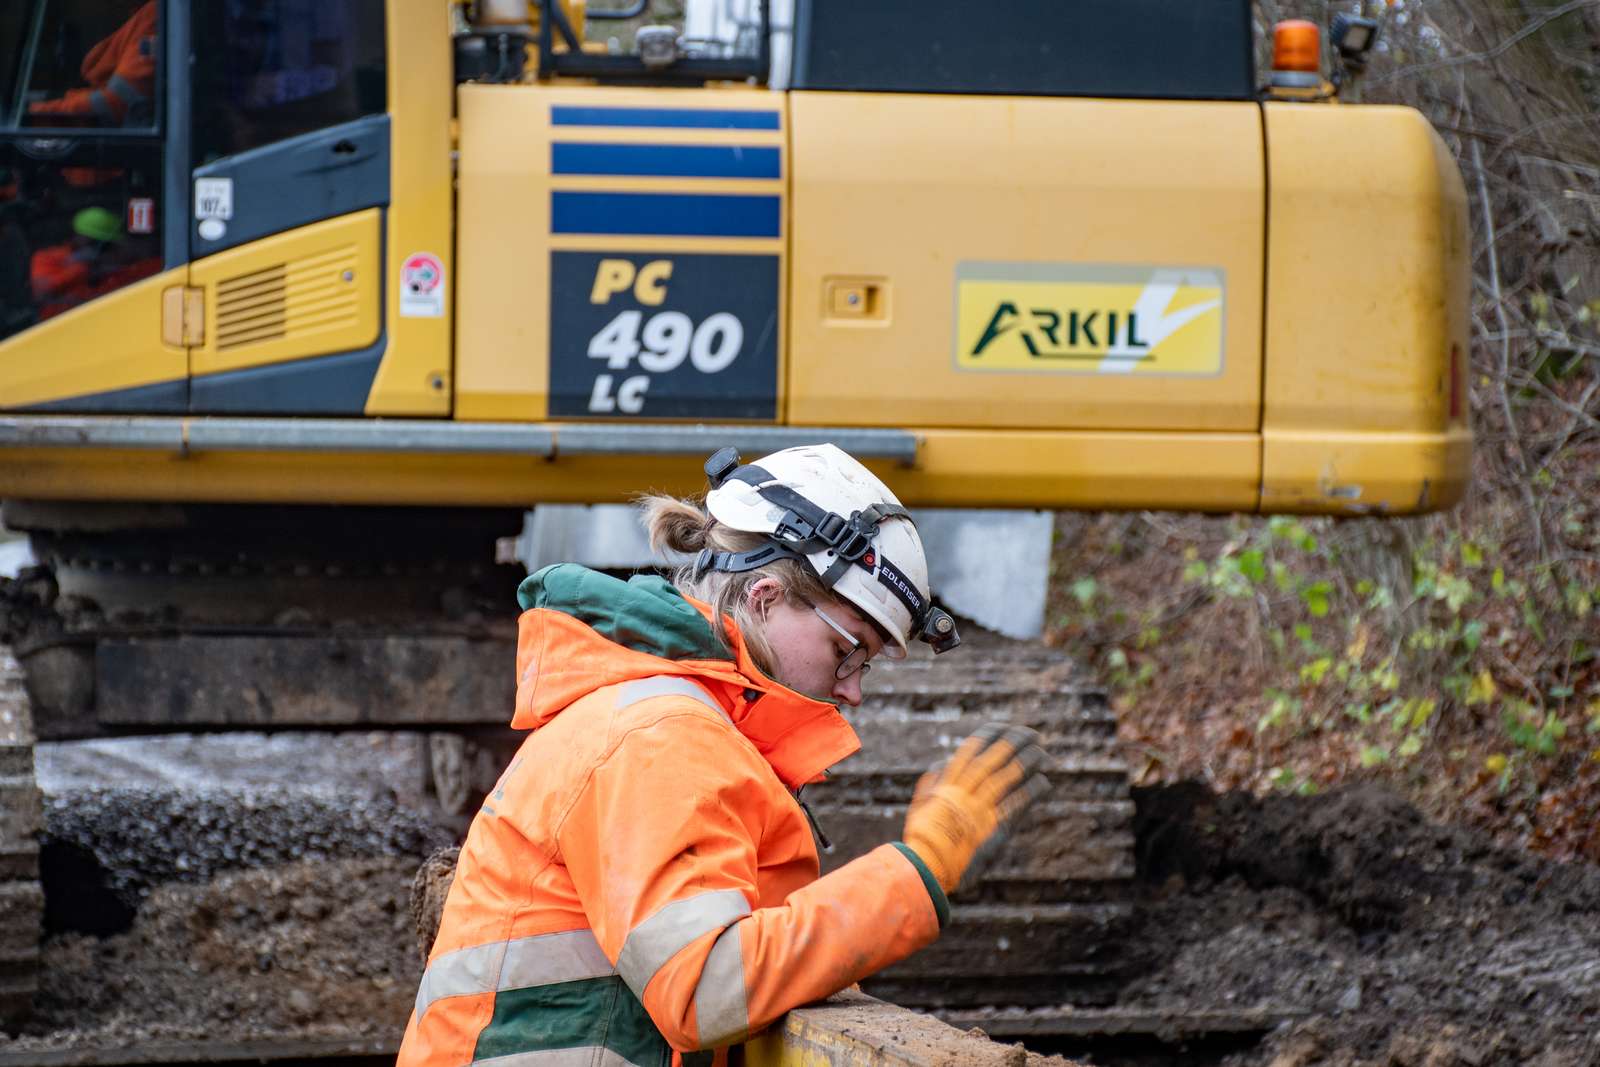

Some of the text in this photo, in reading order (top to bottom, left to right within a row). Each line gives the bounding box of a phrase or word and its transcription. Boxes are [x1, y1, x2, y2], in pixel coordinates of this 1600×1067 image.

[590, 259, 673, 306] PC
[587, 310, 744, 373] 490
[971, 301, 1150, 357] ARKIL
[588, 374, 650, 414] LC
[881, 566, 920, 609] EDLENSER
